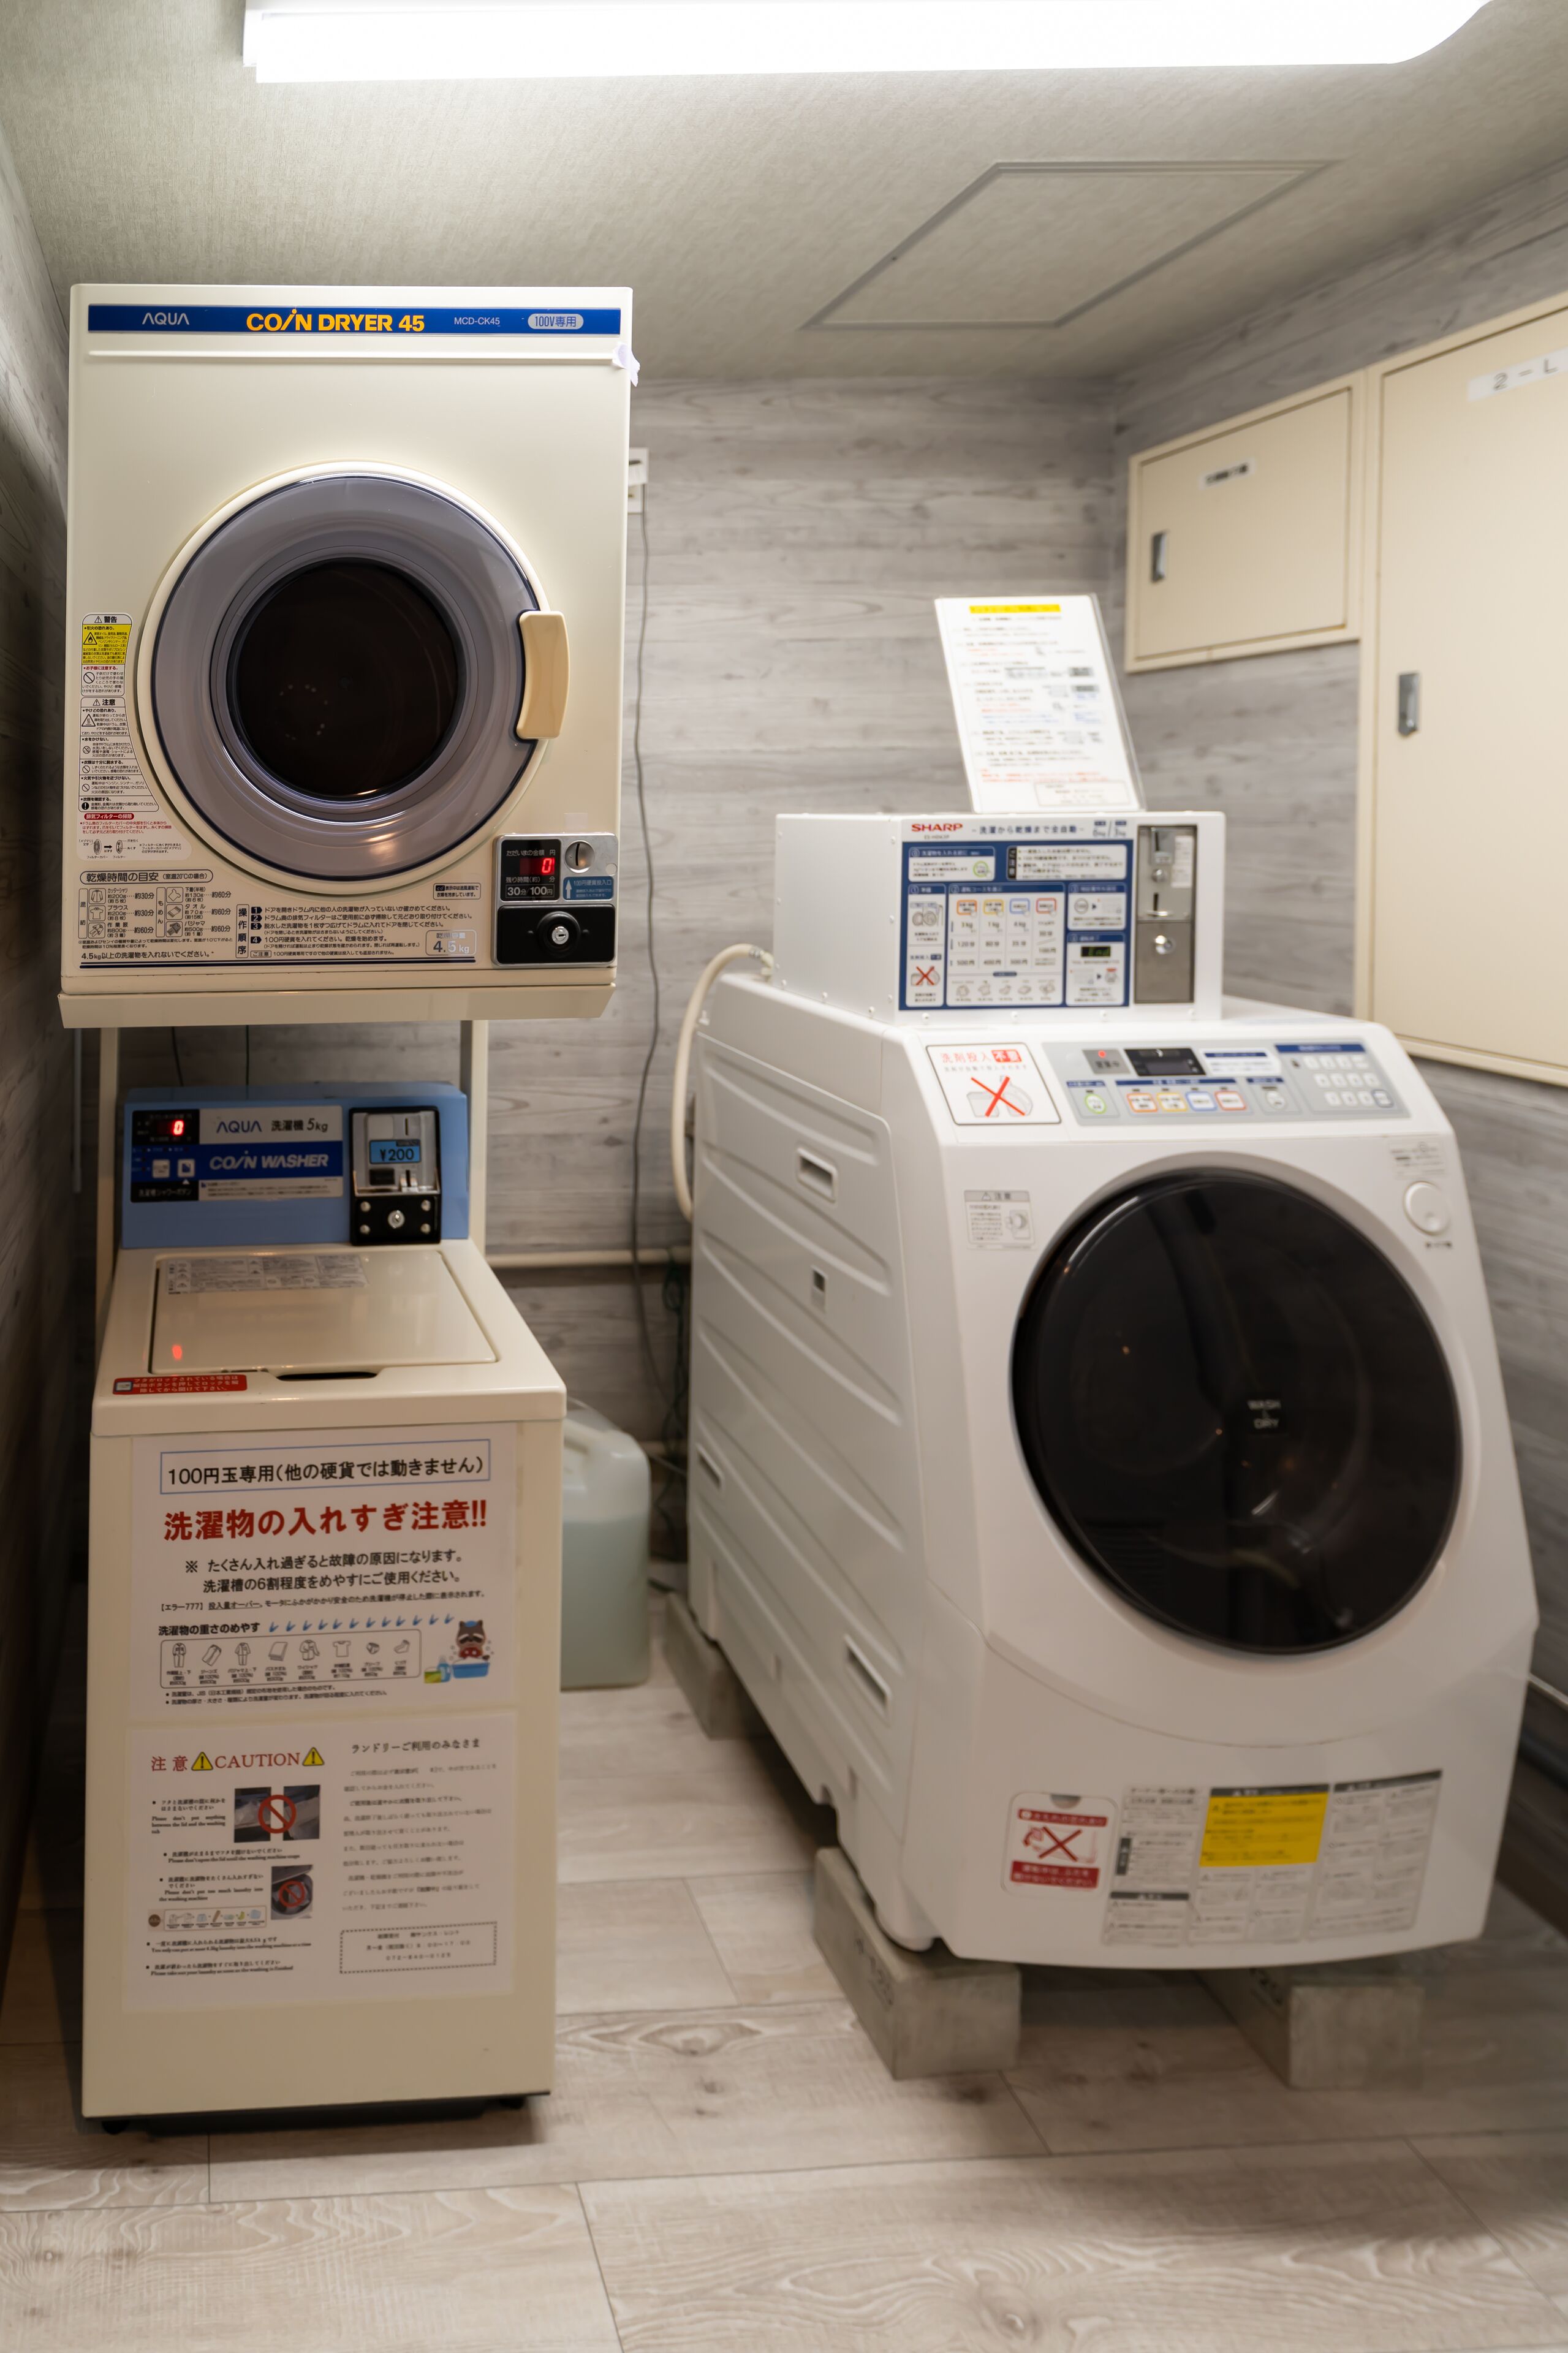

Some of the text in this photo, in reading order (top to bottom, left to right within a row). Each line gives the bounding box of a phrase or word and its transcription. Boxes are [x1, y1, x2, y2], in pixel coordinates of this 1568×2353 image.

[142, 313, 189, 325] AQUA
[246, 308, 425, 332] COIN DRYER 45
[454, 316, 501, 327] MCD-CK45
[535, 314, 577, 329] 100V専用
[912, 824, 963, 832] SHARP
[86, 873, 159, 882] 乾燥時間の目安
[459, 945, 469, 954] kg
[216, 1120, 262, 1134] AQUA
[271, 1120, 303, 1132] 洗濯機
[262, 1153, 328, 1169] WASHER
[380, 1149, 414, 1161] ¥200
[159, 1622, 260, 1636] 洗濯物の重さのめやす
[215, 1752, 300, 1769] CAUTION
